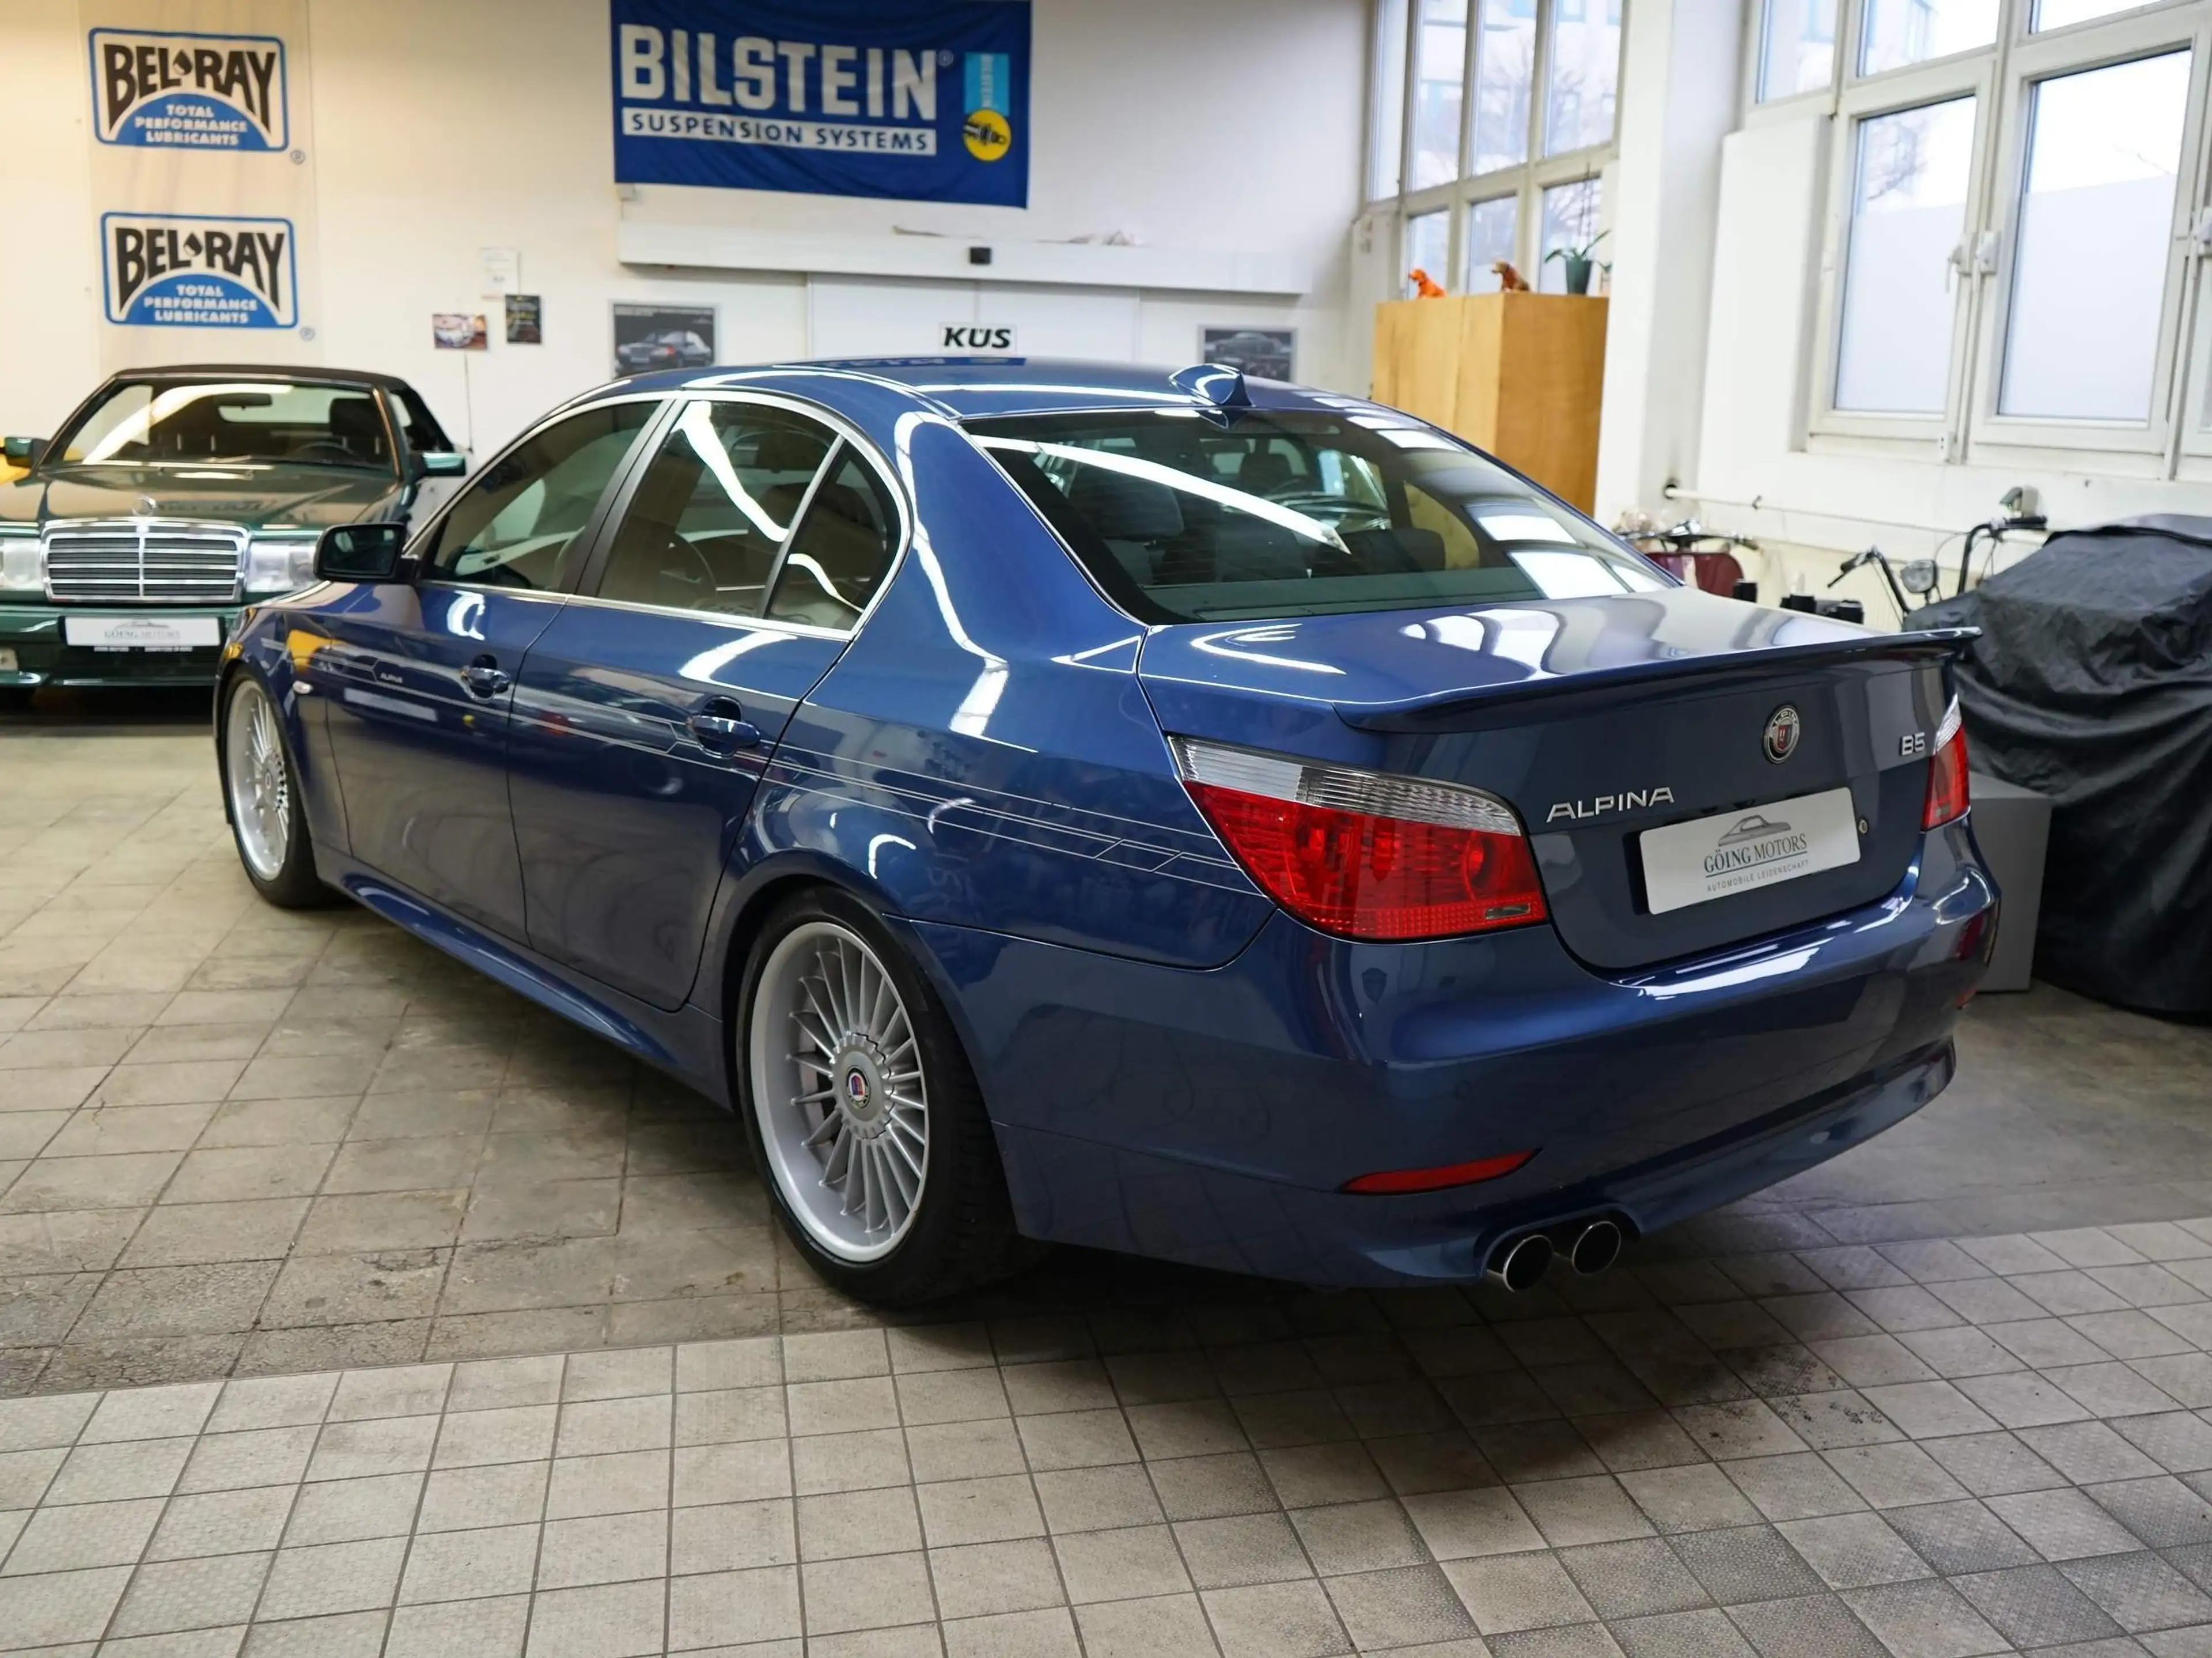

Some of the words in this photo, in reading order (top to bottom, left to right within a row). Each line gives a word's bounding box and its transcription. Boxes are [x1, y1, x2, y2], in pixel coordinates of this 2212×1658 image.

[619, 24, 937, 120] BILSTEIN
[166, 104, 215, 118] TOTAL
[135, 117, 248, 133] PERFORMANCE
[632, 113, 802, 143] SUSPENSION
[816, 128, 927, 150] SYSTEMS
[145, 131, 239, 146] LUBRICANTS
[176, 284, 224, 297] TOTAL
[144, 296, 257, 311] PERFORMANCE
[154, 309, 249, 324] LUBRICANTS
[1900, 732, 1925, 756] B5
[1546, 786, 1675, 823] ALPINA
[1704, 847, 1752, 873] GÖING
[1753, 833, 1808, 861] MOTORS
[1707, 873, 1755, 892] AUTOMOBILE
[1758, 860, 1809, 880] LEIDENSCHAFT
